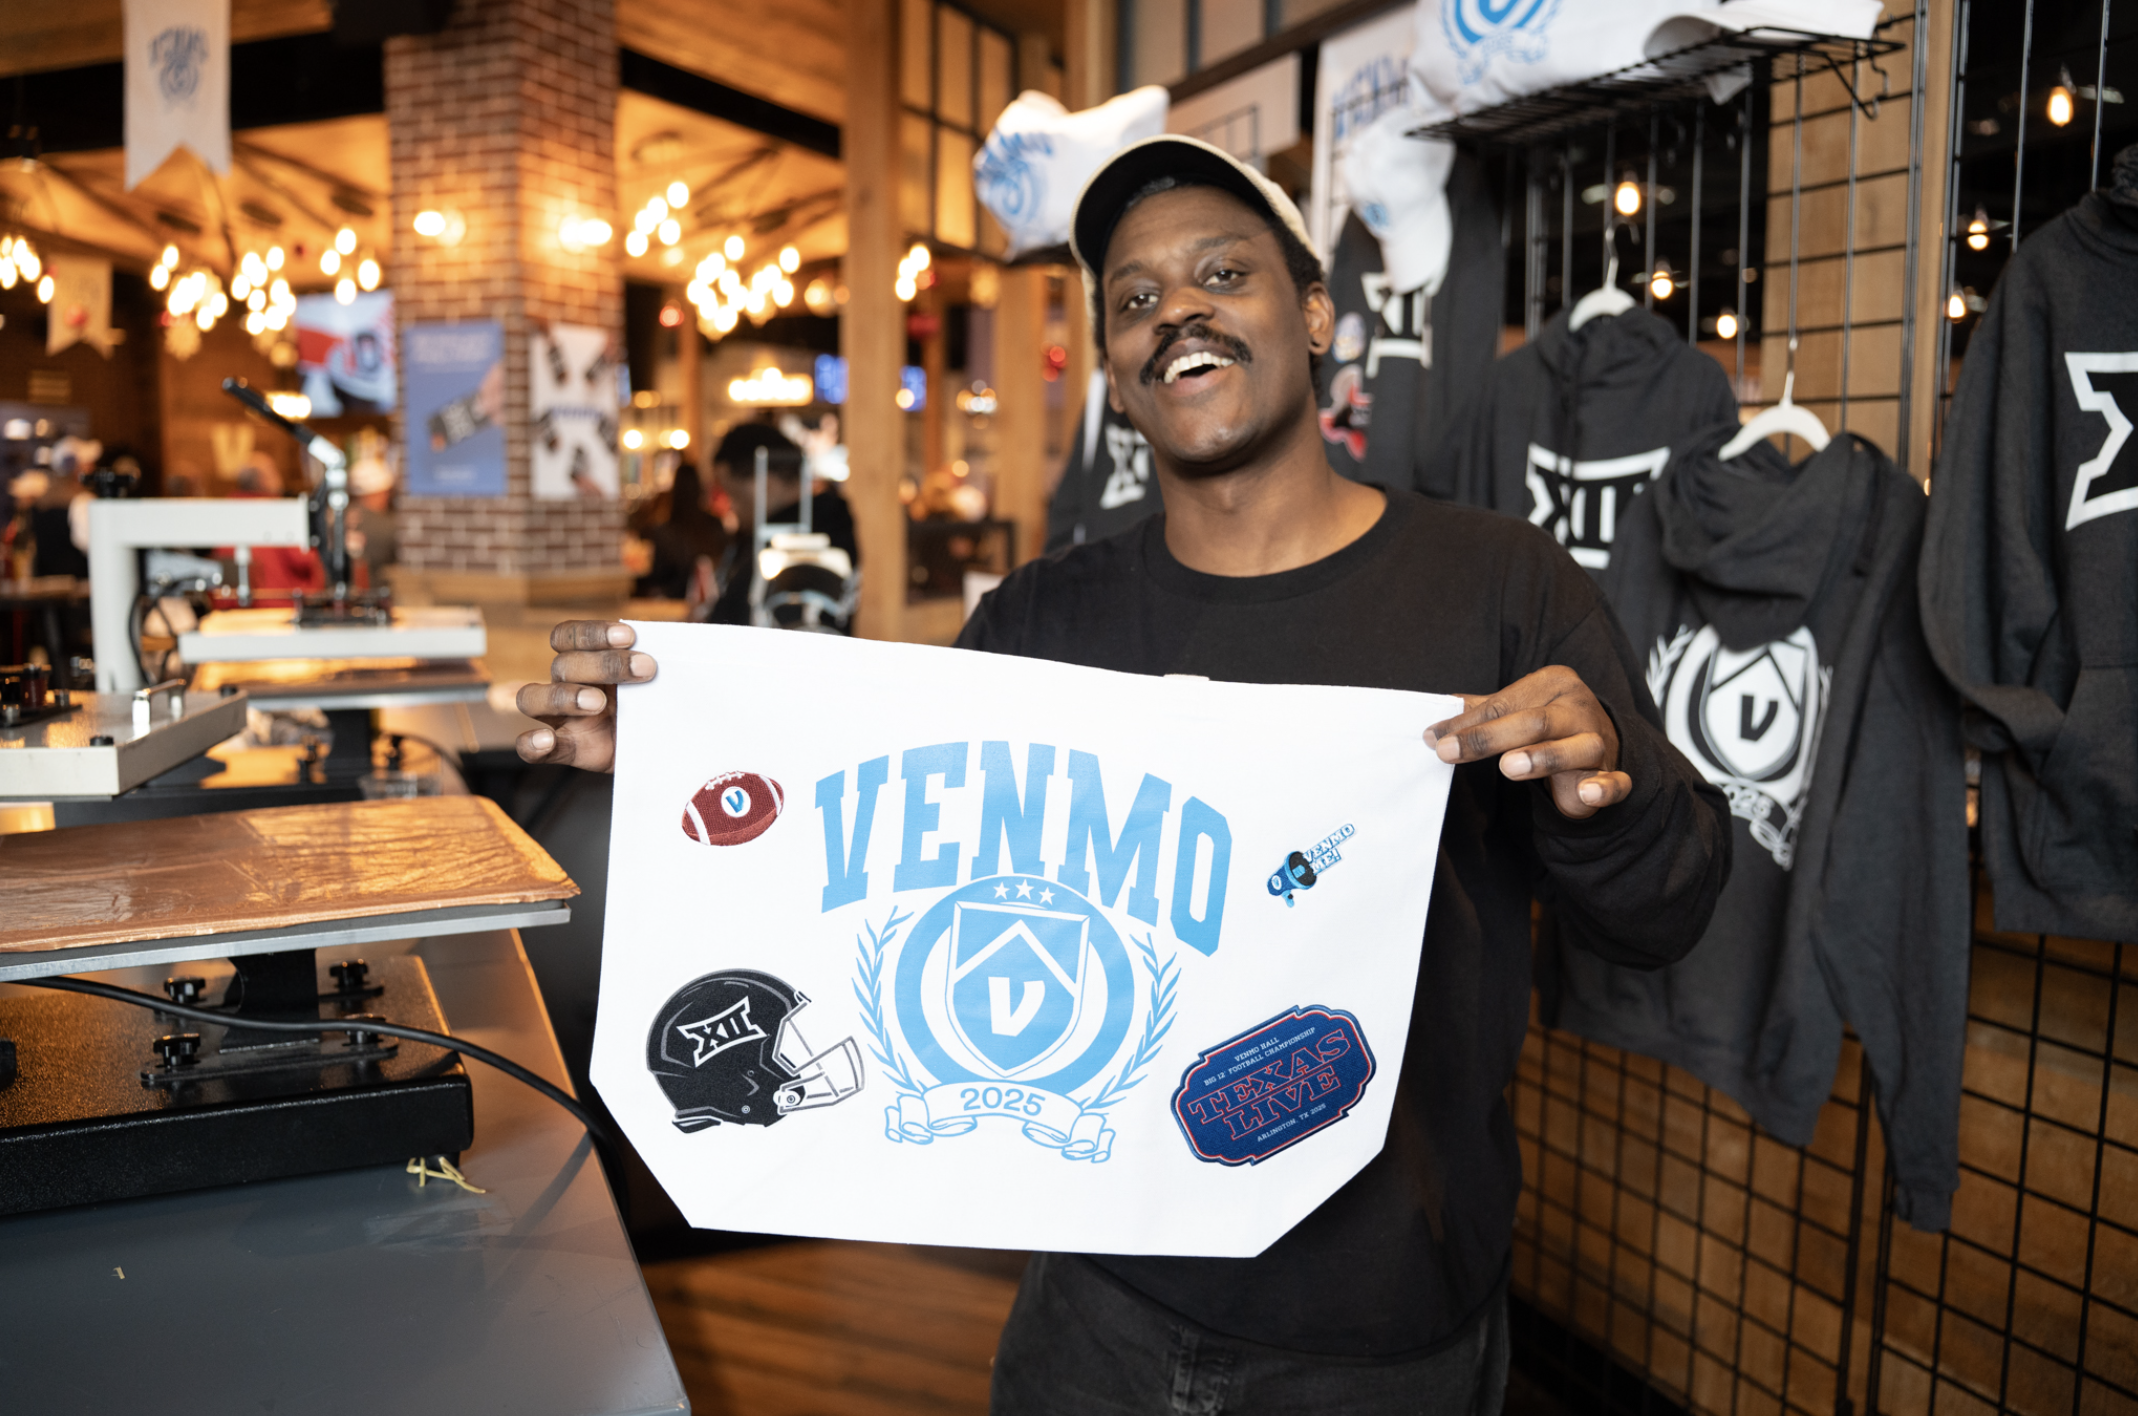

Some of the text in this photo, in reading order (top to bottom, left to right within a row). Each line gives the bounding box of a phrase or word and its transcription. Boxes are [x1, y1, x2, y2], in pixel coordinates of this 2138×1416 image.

[814, 740, 1232, 958] VENMO
[1302, 822, 1356, 864] VENMO
[1309, 846, 1342, 876] ME!
[1203, 1075, 1217, 1087] BIG
[1227, 1054, 1264, 1075] FOOTBALL
[1264, 1026, 1316, 1057] CHAMPIONSHIP
[1234, 1036, 1280, 1062] VENMO HALL
[1187, 1027, 1351, 1125] TEXAS
[960, 1086, 1046, 1117] 2025
[1222, 1064, 1342, 1141] LIVE
[1298, 1111, 1310, 1121] TX
[1309, 1102, 1327, 1116] 2025
